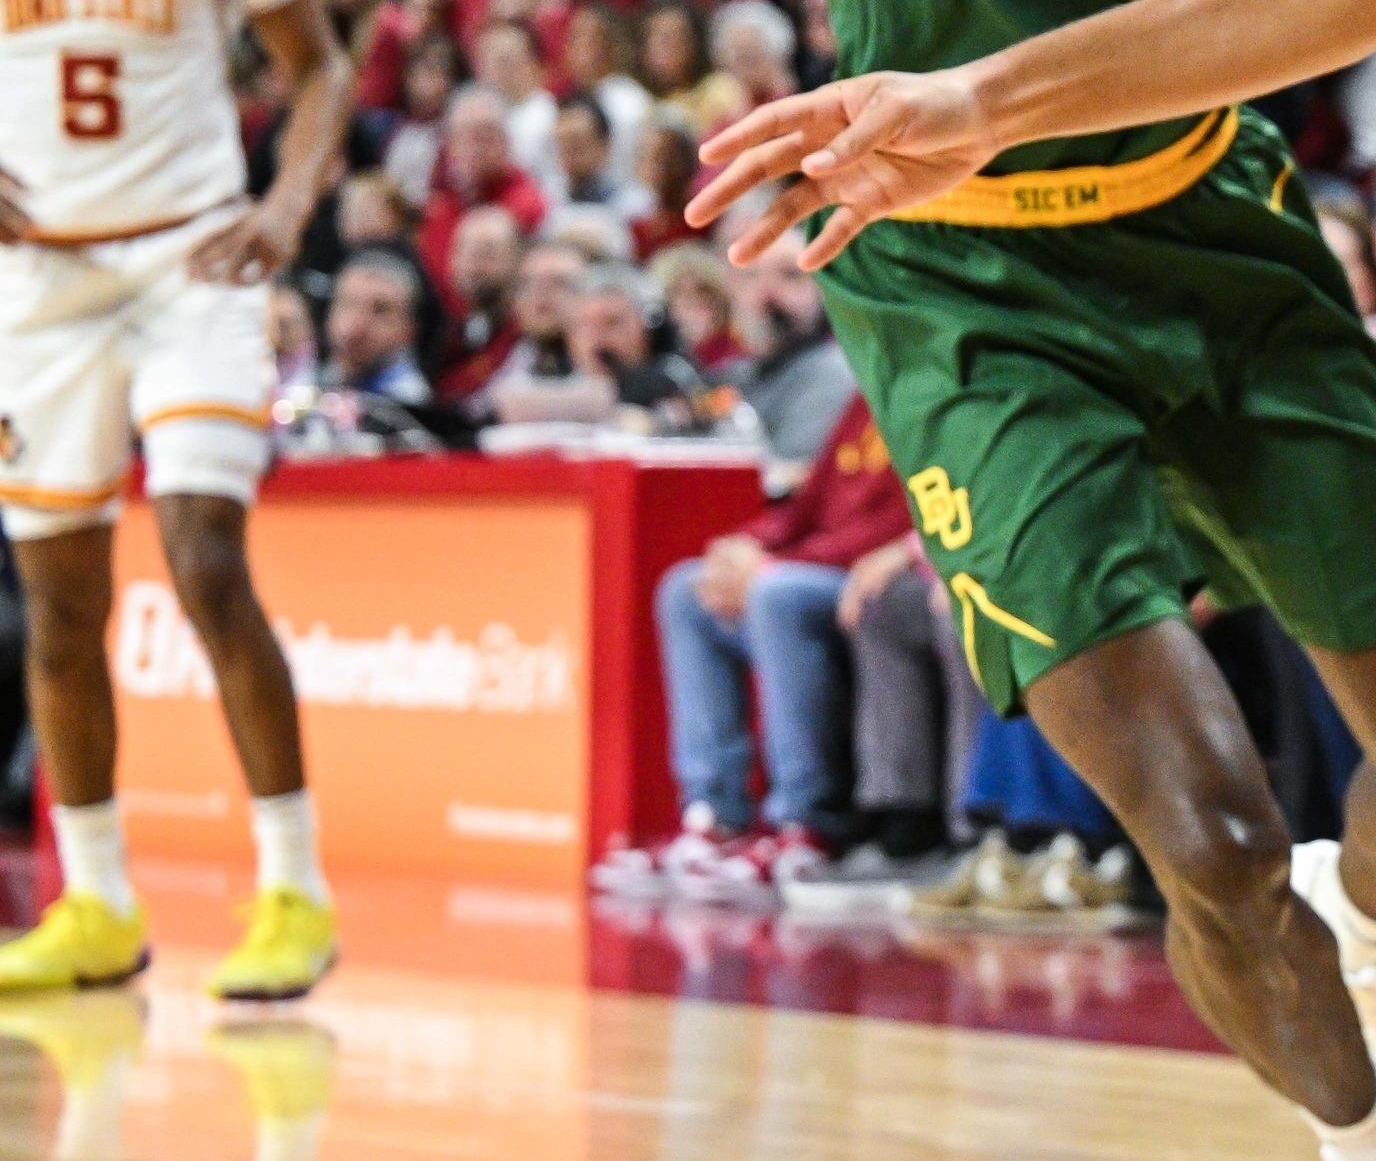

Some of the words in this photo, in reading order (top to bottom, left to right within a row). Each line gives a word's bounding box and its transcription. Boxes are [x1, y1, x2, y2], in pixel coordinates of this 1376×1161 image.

[60, 55, 121, 139] 5
[1014, 186, 1057, 213] SIC
[1064, 183, 1099, 210] EM
